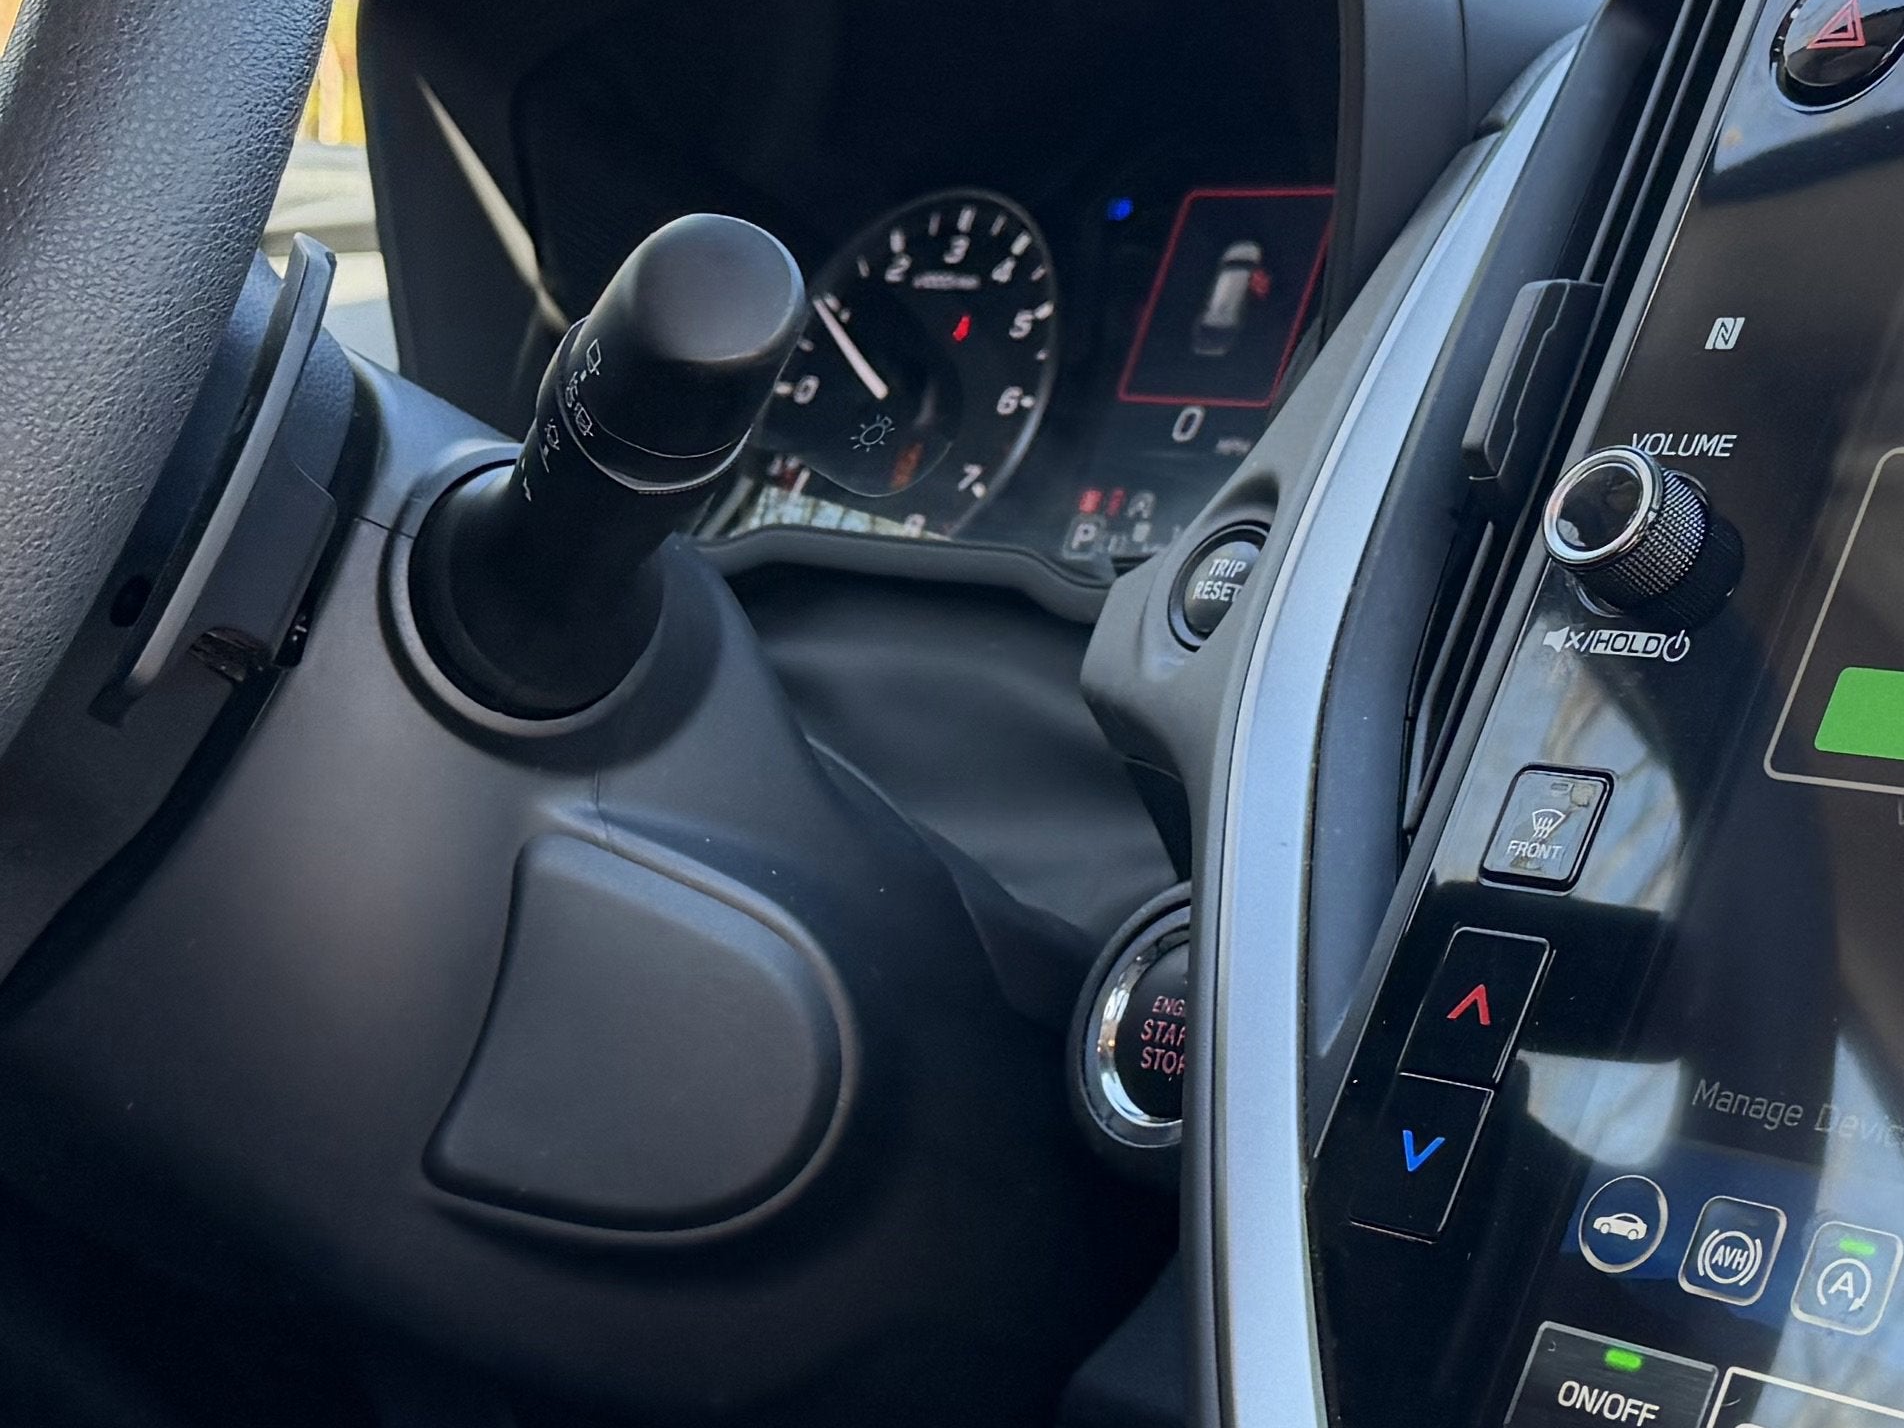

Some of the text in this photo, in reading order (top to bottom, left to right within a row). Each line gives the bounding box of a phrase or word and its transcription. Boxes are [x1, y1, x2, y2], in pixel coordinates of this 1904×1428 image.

[1171, 406, 1205, 442] 0
[1630, 432, 1738, 459] VOLUME
[1209, 557, 1247, 579] TRIP
[1192, 580, 1245, 603] RESET
[1506, 839, 1564, 863] FRONT
[1151, 995, 1185, 1017] ENG
[1691, 1078, 1804, 1130] Manage
[1710, 1244, 1750, 1272] AVH
[1556, 1379, 1661, 1428] ON/OFF
